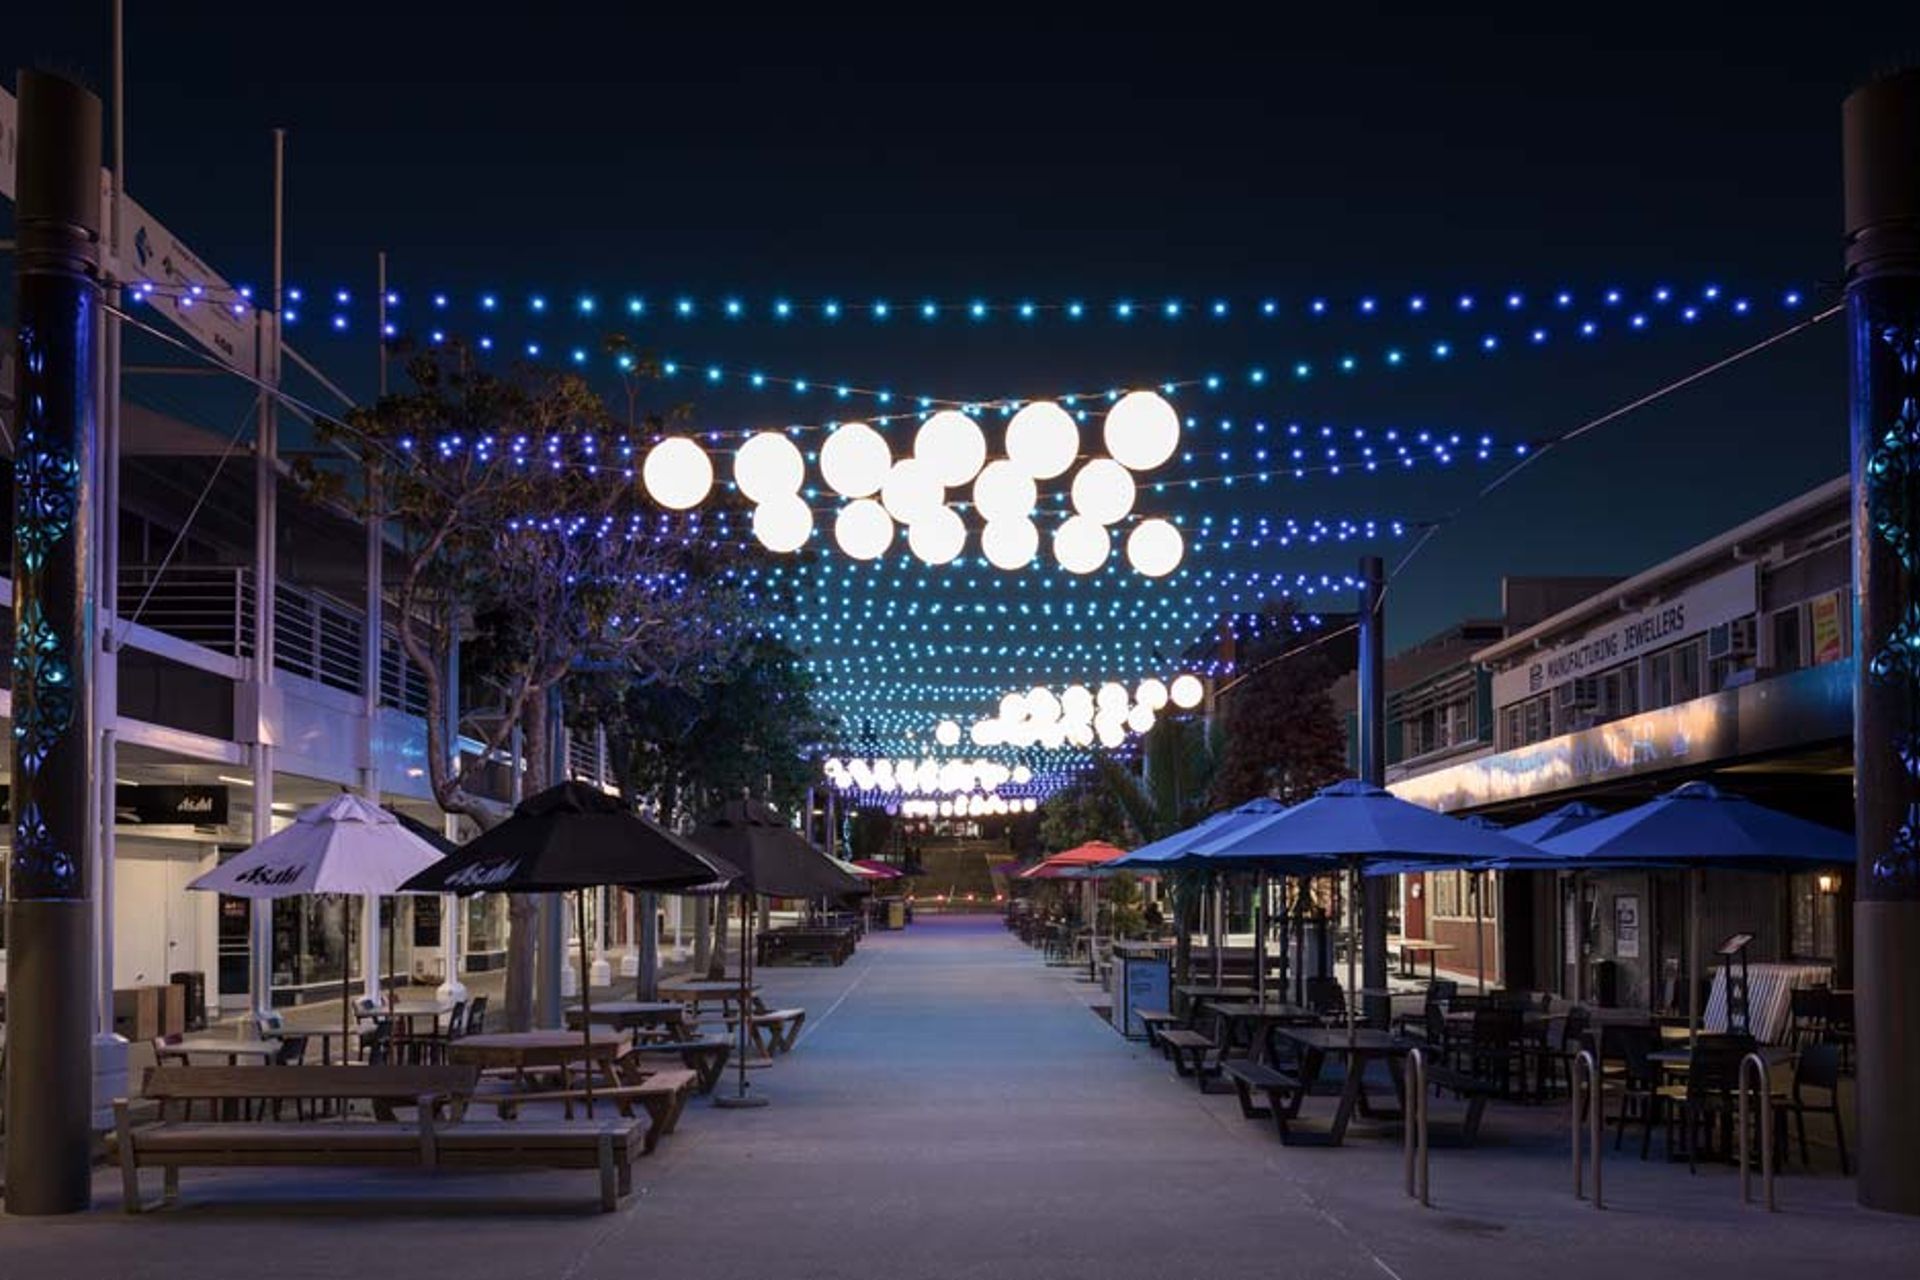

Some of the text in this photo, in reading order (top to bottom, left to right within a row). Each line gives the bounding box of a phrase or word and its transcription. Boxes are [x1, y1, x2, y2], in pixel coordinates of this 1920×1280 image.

[1547, 633, 1618, 679] MANUFACTURING
[1623, 604, 1685, 651] JEWELLERS
[235, 864, 306, 886] Asahi
[444, 858, 523, 887] Asahi
